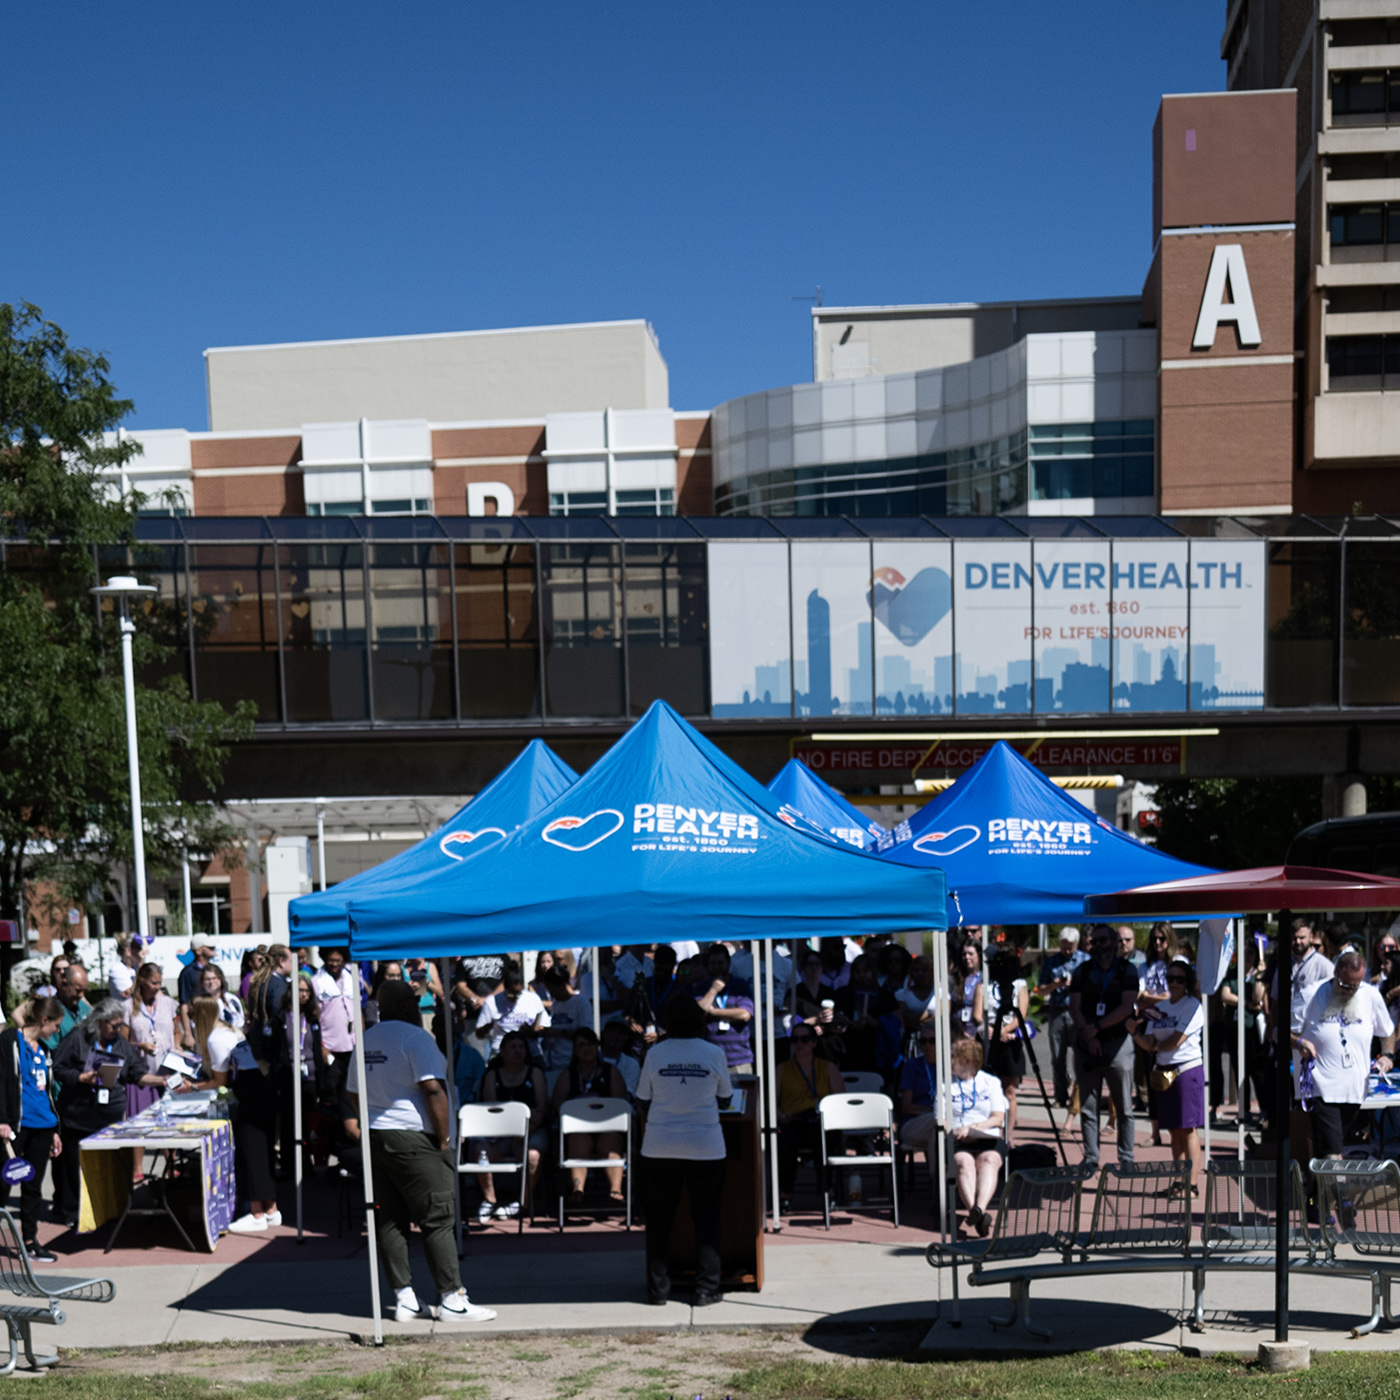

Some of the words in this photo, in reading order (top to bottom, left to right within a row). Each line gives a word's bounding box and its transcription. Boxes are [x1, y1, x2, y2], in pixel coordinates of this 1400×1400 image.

[1192, 244, 1262, 347] A
[964, 562, 1106, 590] DENVER
[1112, 562, 1243, 589] HEALTH
[1069, 602, 1101, 615] est.
[1024, 627, 1053, 640] FOR
[1060, 627, 1109, 640] LIFE'S
[1112, 626, 1188, 640] JOURNEY
[796, 751, 825, 769] NO
[831, 750, 873, 768] FIRE
[879, 750, 930, 767] DEPT.
[934, 749, 984, 766] ACCE
[1029, 747, 1136, 765] CLEARANCE
[634, 804, 759, 828] DENVER
[633, 818, 759, 839] HEALTH
[988, 818, 1091, 834] DENVER
[662, 836, 690, 845] est.
[694, 837, 729, 846] 1860
[988, 830, 1091, 844] HEALTH
[632, 844, 657, 852] FOR
[699, 846, 758, 854] JOURNEY
[155, 918, 167, 936] B
